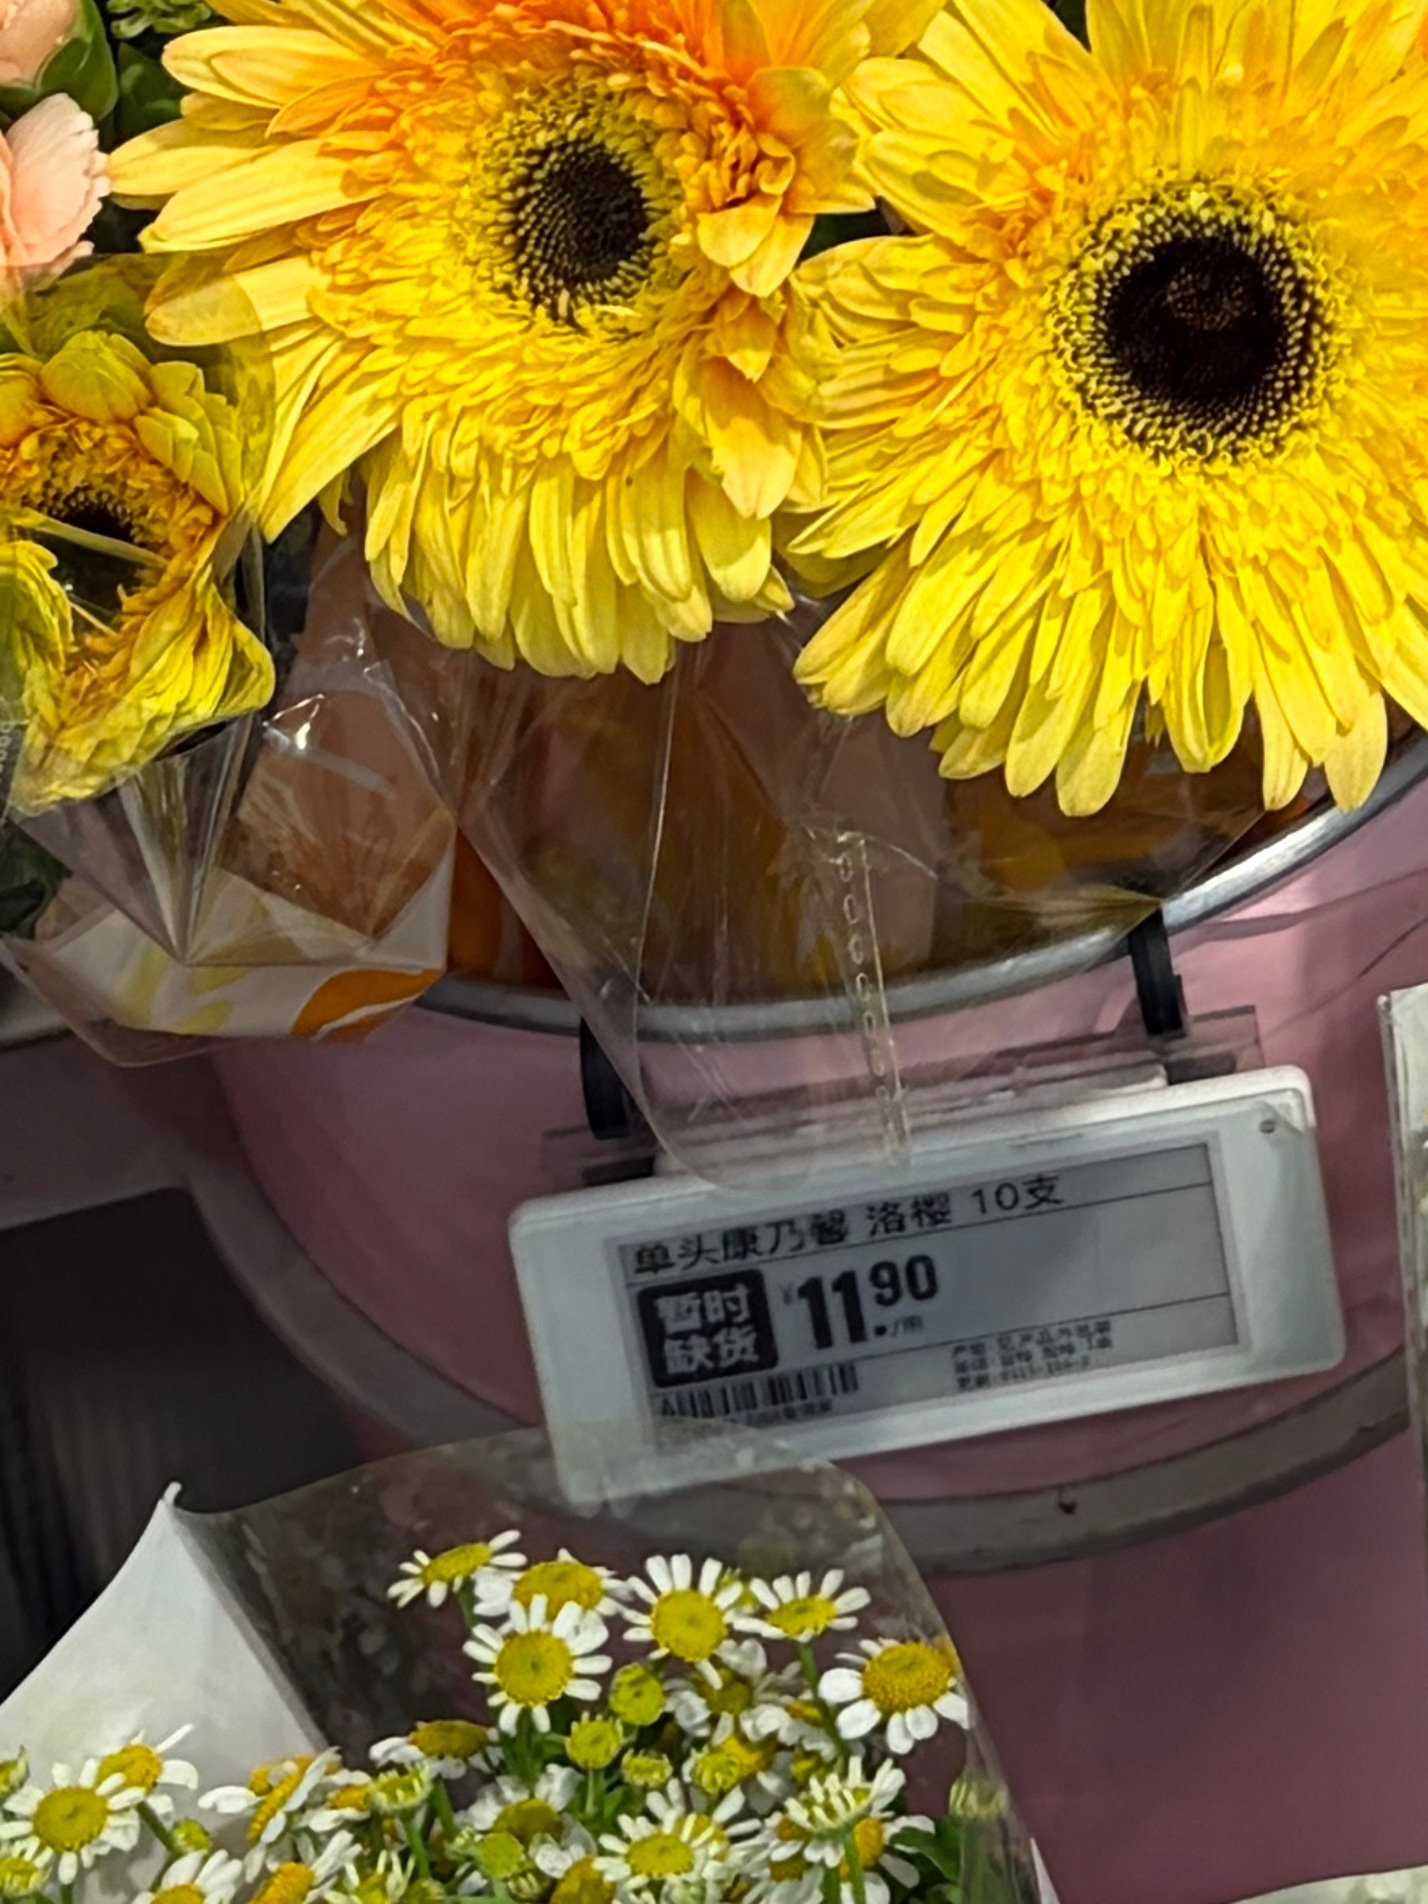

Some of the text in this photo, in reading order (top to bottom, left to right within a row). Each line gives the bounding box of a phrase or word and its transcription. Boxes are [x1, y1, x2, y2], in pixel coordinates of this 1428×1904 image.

[632, 1207, 852, 1275] 单头康乃馨
[970, 1172, 1066, 1215] 10支
[663, 1327, 762, 1377] 缺货
